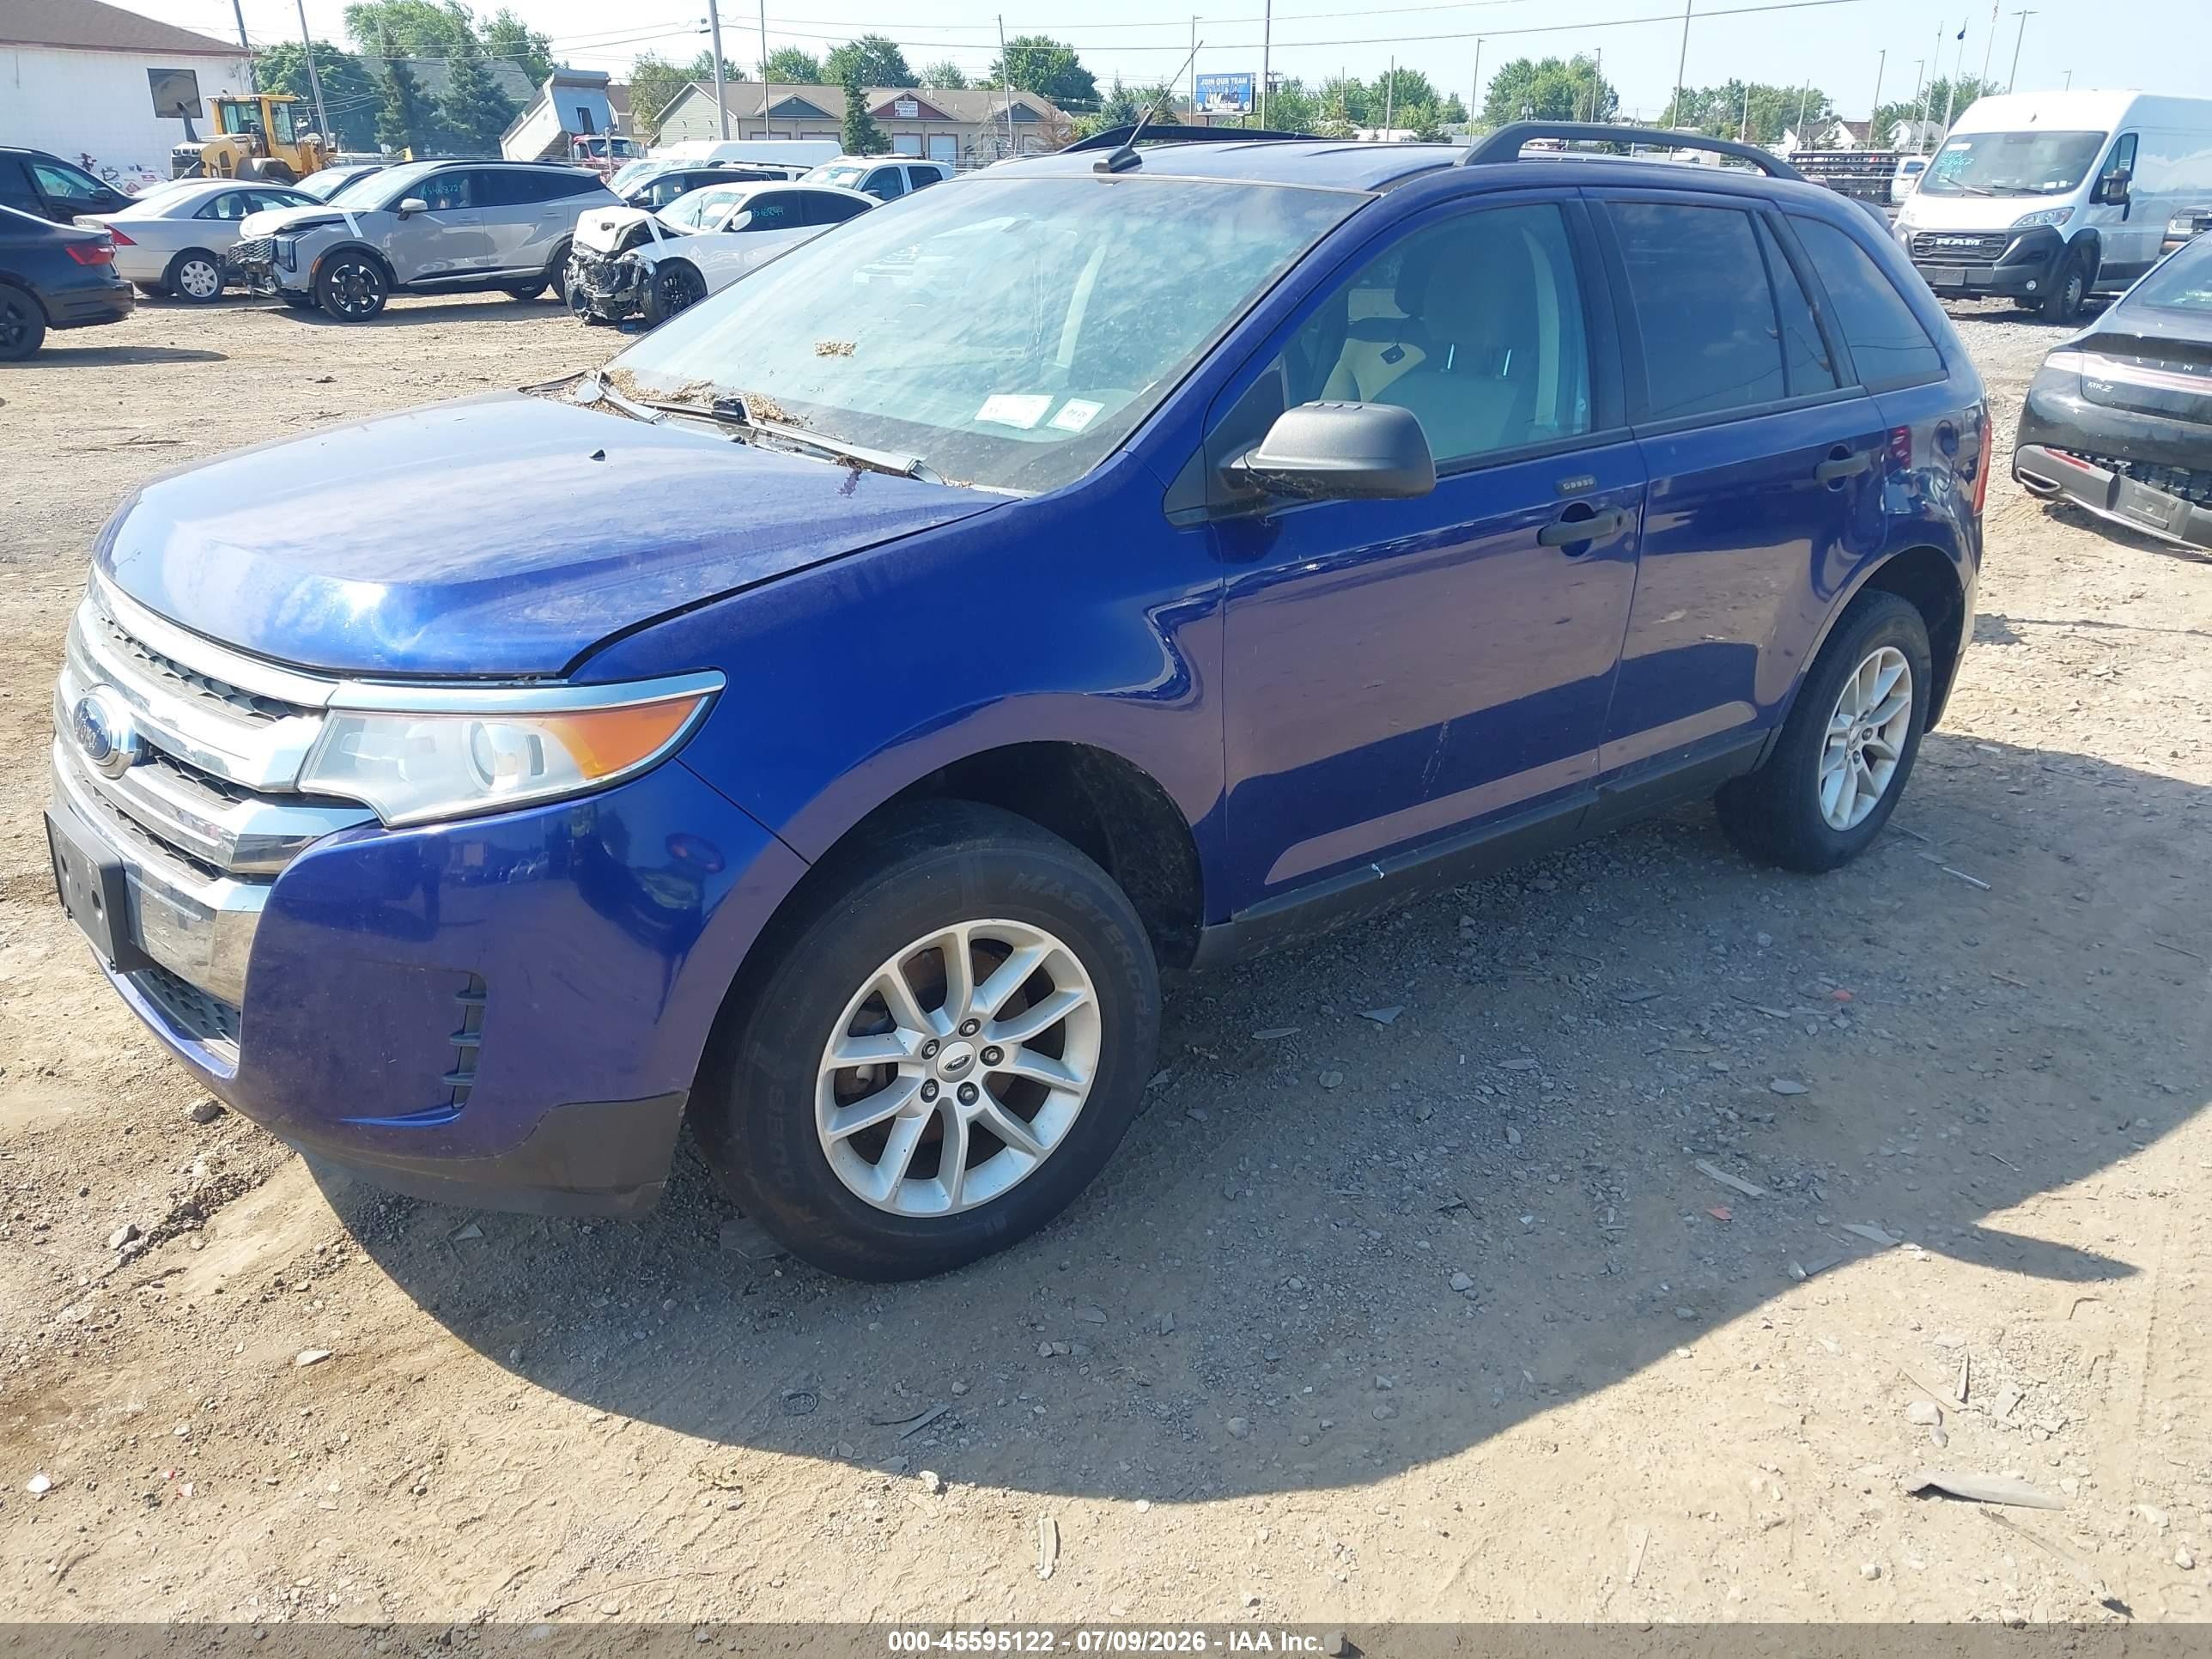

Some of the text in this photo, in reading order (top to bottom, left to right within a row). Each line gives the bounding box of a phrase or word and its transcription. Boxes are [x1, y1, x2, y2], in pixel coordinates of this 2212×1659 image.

[1935, 237, 1981, 247] RAM
[2087, 380, 2115, 392] MKZ
[1007, 871, 1149, 1086] MASTERCRAF
